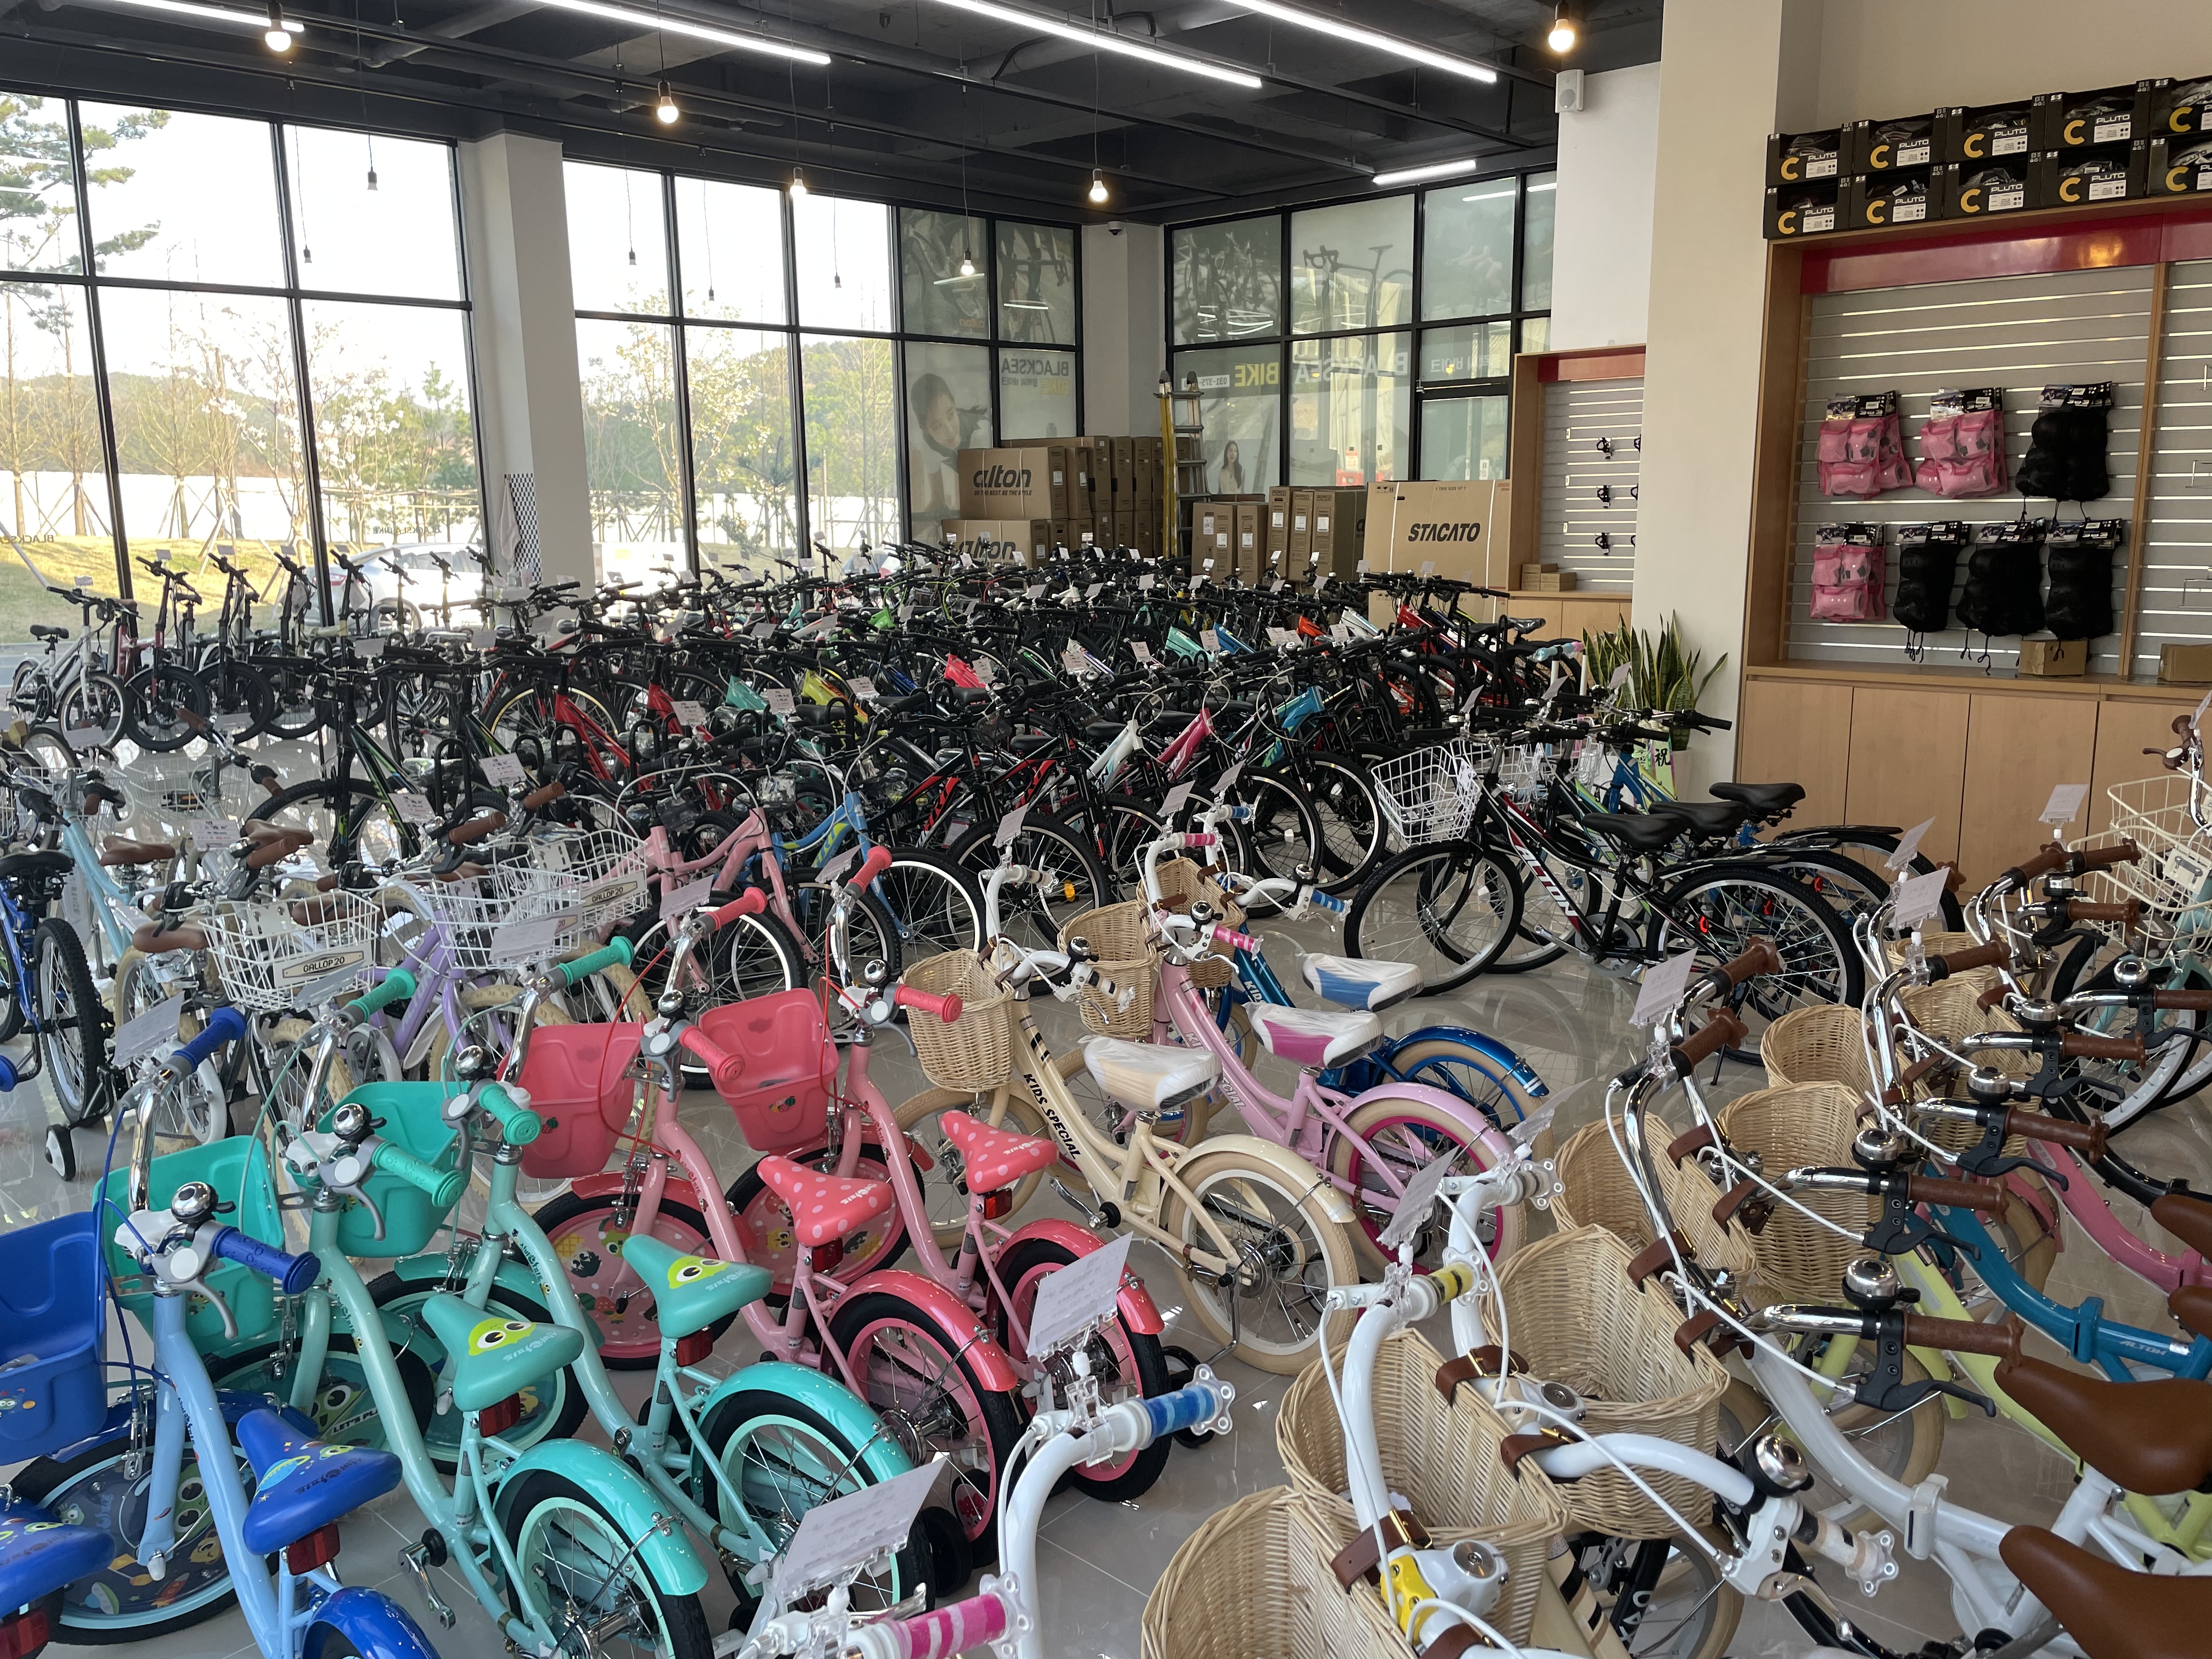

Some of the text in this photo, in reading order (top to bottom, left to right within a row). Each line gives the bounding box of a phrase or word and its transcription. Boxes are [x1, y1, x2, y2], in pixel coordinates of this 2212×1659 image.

[2096, 114, 2130, 124] PLUTO
[1994, 128, 2027, 137] PLUTO
[1899, 139, 1929, 149] PLUTO
[1808, 152, 1837, 161] PLUTO
[2091, 172, 2125, 182] PLUTO
[1991, 183, 2023, 193] PLUTO
[1895, 196, 1926, 204] PLUTO
[1805, 207, 1834, 216] PLUTO
[973, 465, 1032, 488] alton
[1408, 523, 1481, 542] STACATO
[1655, 748, 1671, 766] 祝
[1514, 845, 1578, 916] ALTON
[592, 891, 614, 902] GALLOP
[303, 956, 345, 973] GALLOP 20
[1023, 1074, 1081, 1160] KIDS SPECIAL
[2120, 1340, 2166, 1355] ALTON
[334, 1414, 361, 1433] LET'S
